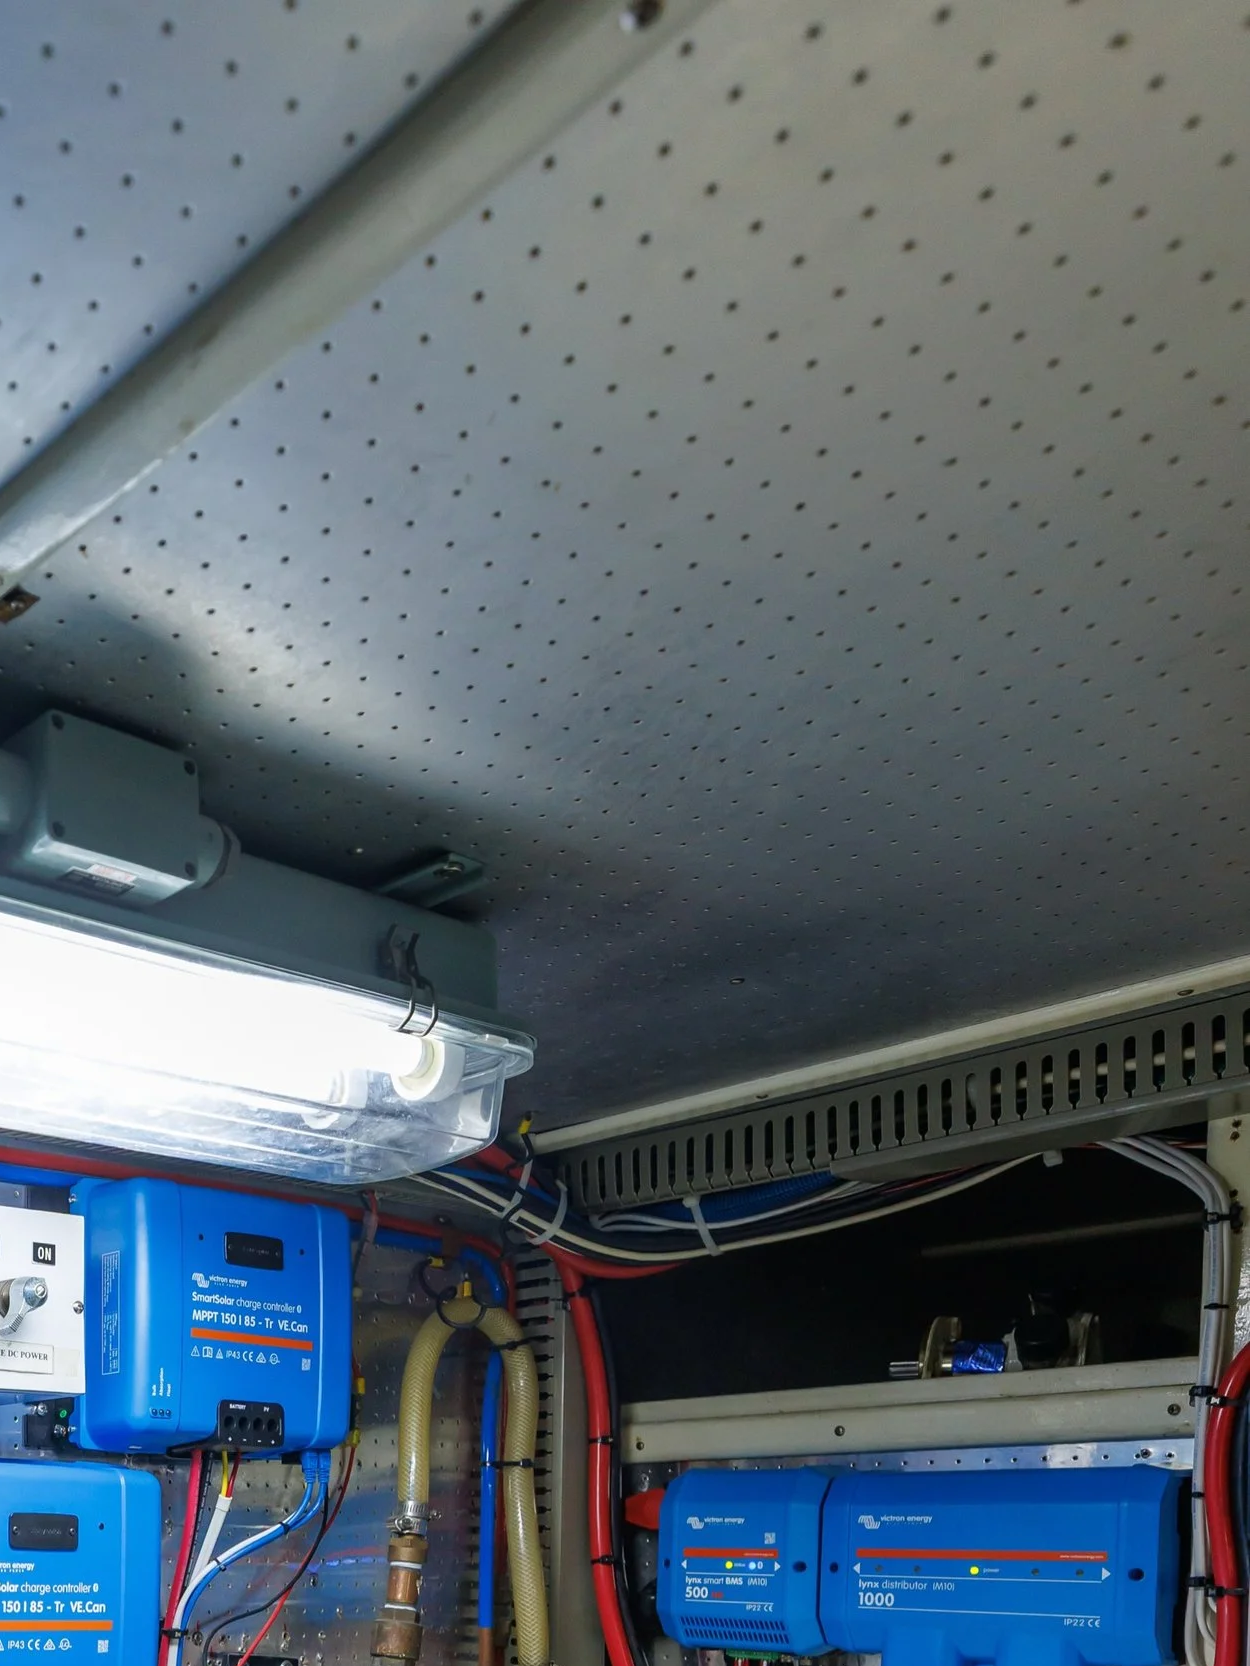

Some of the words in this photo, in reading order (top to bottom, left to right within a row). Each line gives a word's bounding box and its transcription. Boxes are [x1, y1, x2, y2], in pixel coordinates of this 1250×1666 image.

[37, 1246, 52, 1261] ON
[209, 1274, 228, 1283] victron
[229, 1278, 248, 1287] energy
[192, 1291, 235, 1306] SmartSolar
[236, 1298, 261, 1311] charge
[263, 1301, 295, 1313] controller
[192, 1309, 219, 1321] MPPT
[221, 1312, 237, 1325] 150
[244, 1316, 255, 1327] 85
[265, 1318, 273, 1329] Tr
[278, 1320, 308, 1333] VE.Can
[8, 1350, 19, 1358] DC
[20, 1351, 48, 1360] POWER
[880, 1514, 905, 1522] victron
[906, 1515, 932, 1523] energy
[12, 1562, 35, 1571] energy
[685, 1576, 701, 1585] lynx
[703, 1577, 724, 1585] smart
[725, 1577, 743, 1586] BMS
[747, 1578, 768, 1587] (M10)
[858, 1579, 879, 1590] lynx
[881, 1579, 927, 1591] distributor
[932, 1581, 955, 1591] (M10)
[20, 1582, 51, 1595] charge
[53, 1582, 91, 1593] controller
[685, 1586, 708, 1598] 500
[858, 1592, 894, 1606] 1000
[1, 1601, 21, 1613] 150
[29, 1601, 43, 1613] 85
[54, 1601, 65, 1613] Tr
[70, 1601, 106, 1613] VE.Can
[1064, 1618, 1085, 1627] IP22
[7, 1640, 25, 1649] IP43
